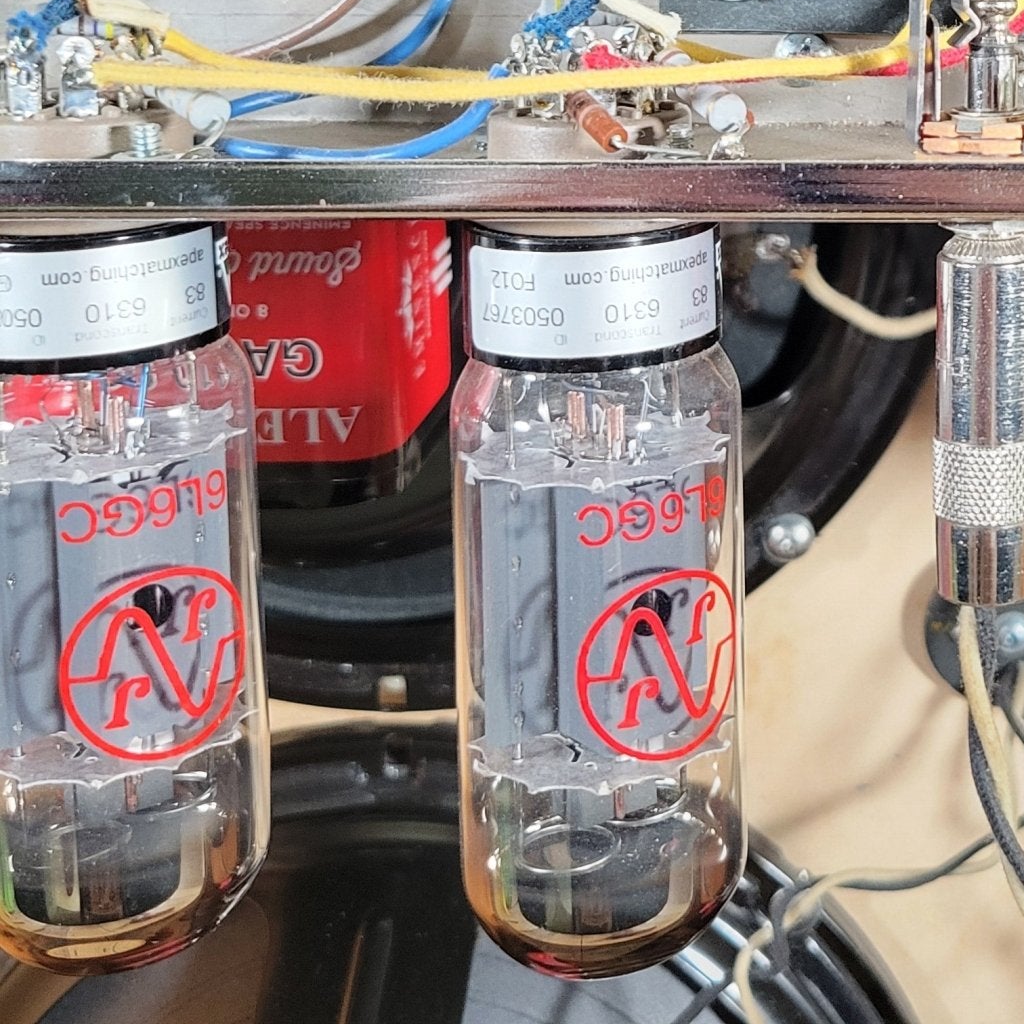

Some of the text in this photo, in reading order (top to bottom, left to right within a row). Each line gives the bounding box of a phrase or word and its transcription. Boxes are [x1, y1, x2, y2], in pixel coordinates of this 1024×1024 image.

[41, 248, 204, 286] apexmatching.com
[249, 240, 361, 288] Sound
[565, 251, 708, 286] apexmatching.com
[0, 282, 205, 328] 83 6310 050
[482, 284, 708, 326] 83 6310 0503767
[59, 469, 226, 544] 6L6GC
[577, 477, 725, 548] 6L6GC
